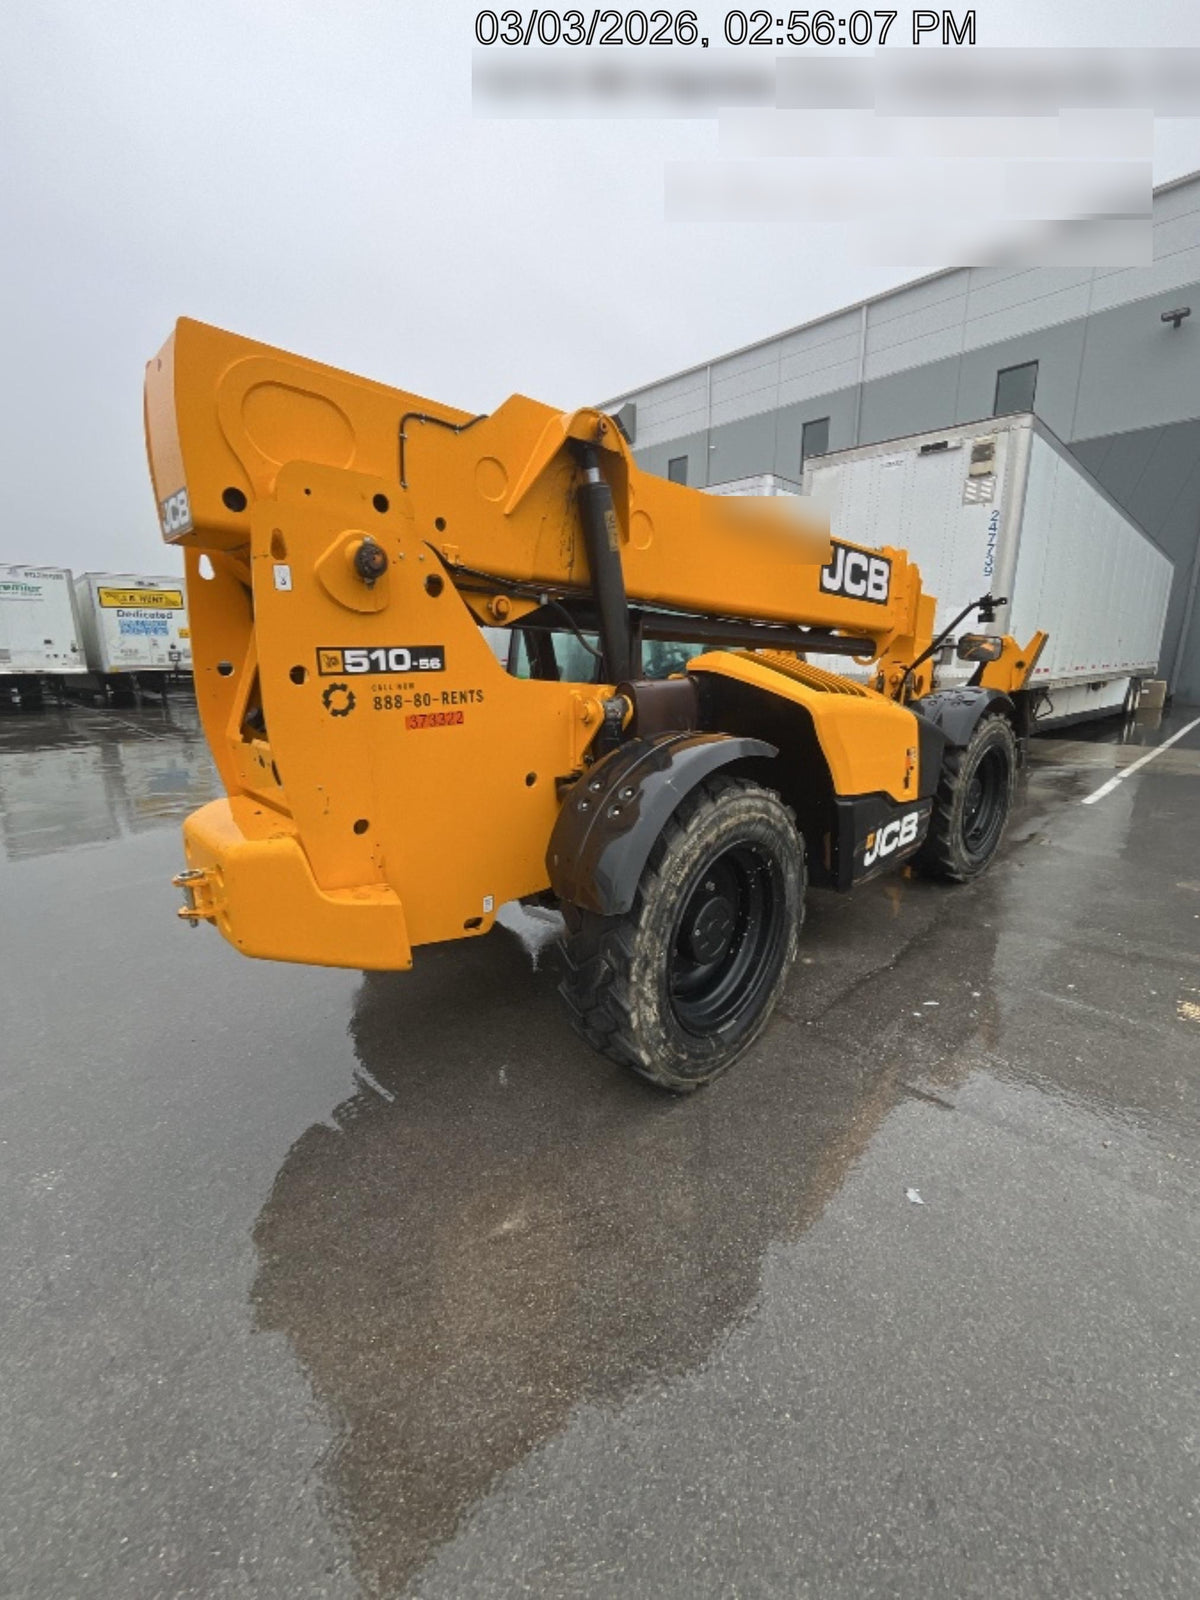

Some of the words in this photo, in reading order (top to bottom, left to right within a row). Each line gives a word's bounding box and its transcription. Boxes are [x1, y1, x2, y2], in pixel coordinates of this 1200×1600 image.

[164, 489, 189, 534] JCB
[821, 547, 890, 601] JCB
[116, 609, 173, 619] Dedicated
[343, 648, 441, 673] 510-56
[371, 683, 393, 692] CALL
[373, 689, 484, 710] 888-80-RENTS
[409, 711, 464, 730] 373322
[863, 811, 919, 867] JCB
